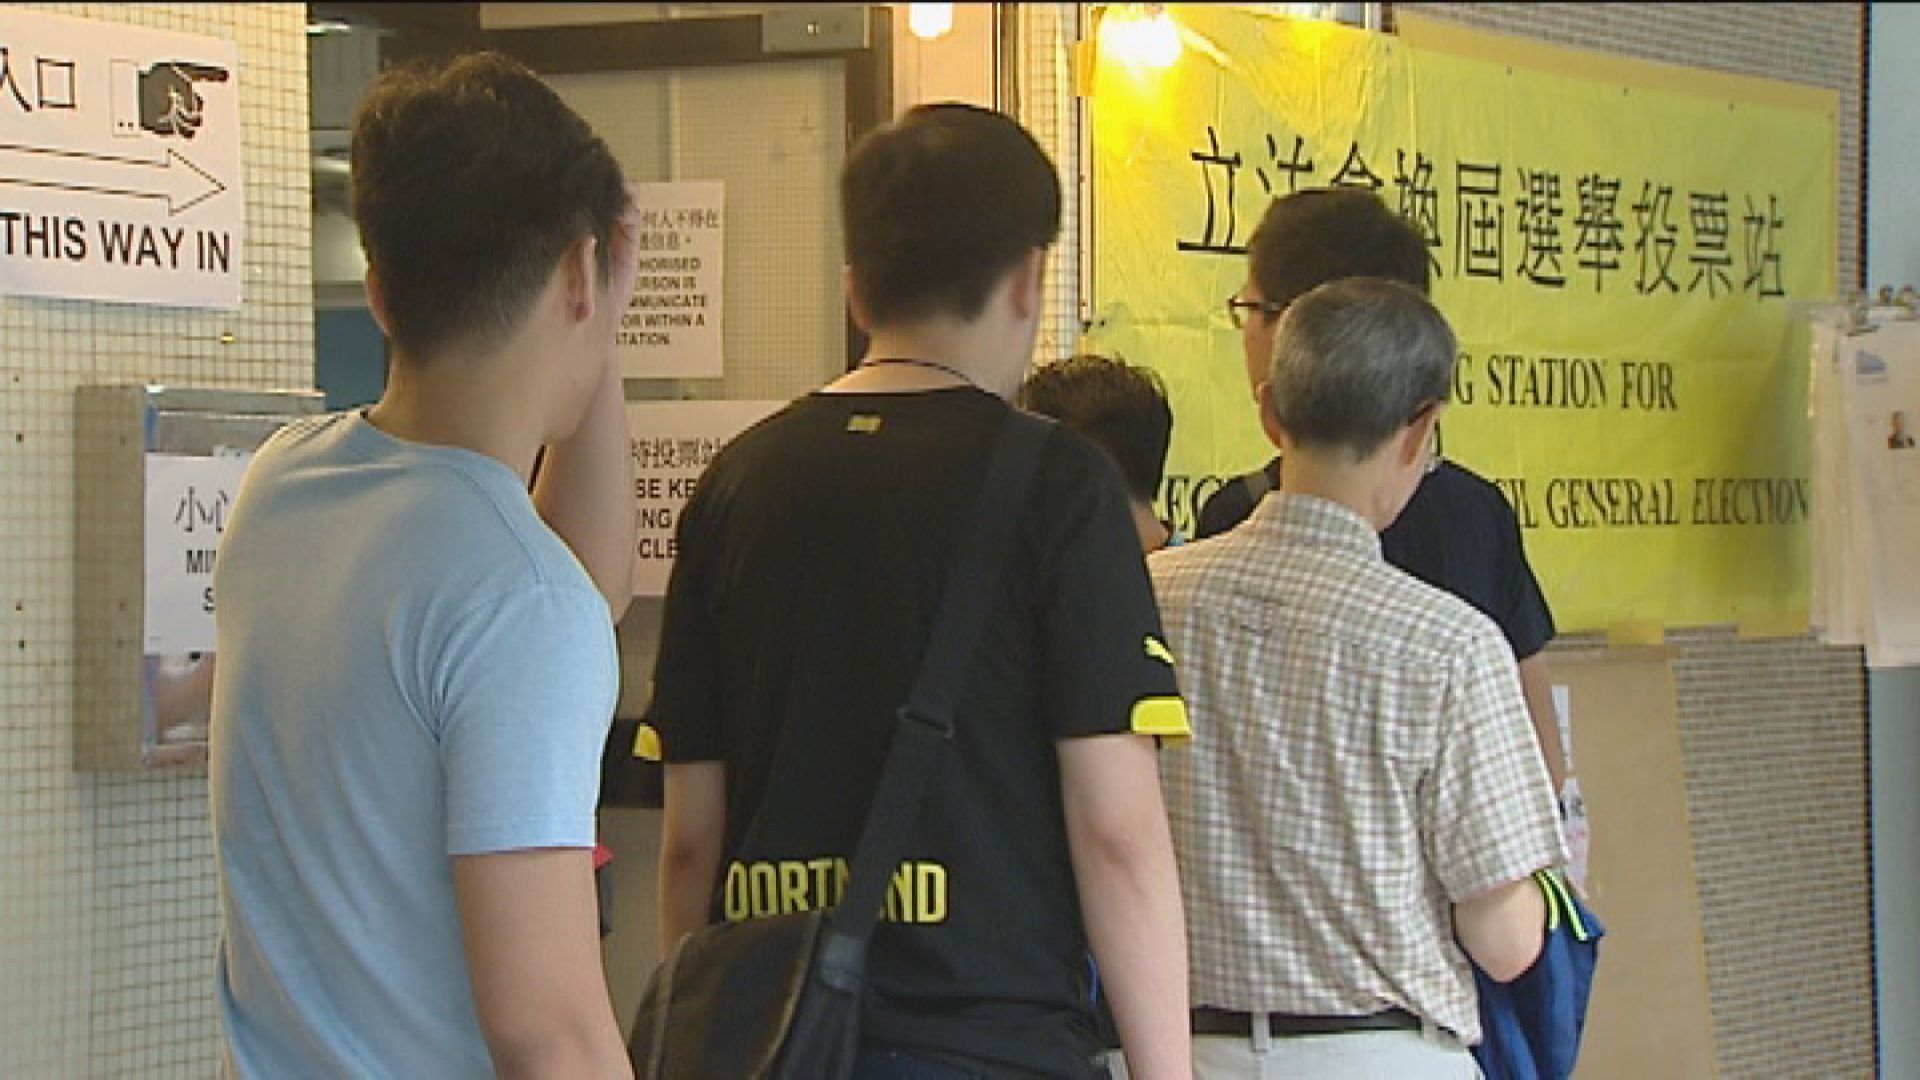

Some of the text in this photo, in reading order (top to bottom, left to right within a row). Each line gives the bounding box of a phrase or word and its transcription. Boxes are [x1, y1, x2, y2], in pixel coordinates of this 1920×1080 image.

[0, 212, 231, 273] THIS WAY IN
[639, 257, 702, 272] HORISED
[643, 313, 692, 328] WITHIN
[695, 313, 706, 327] A
[1486, 354, 1609, 409] STATION
[1620, 361, 1678, 411] FOR
[1546, 477, 1681, 530] GENERAL
[1690, 477, 1810, 527] ELECTION
